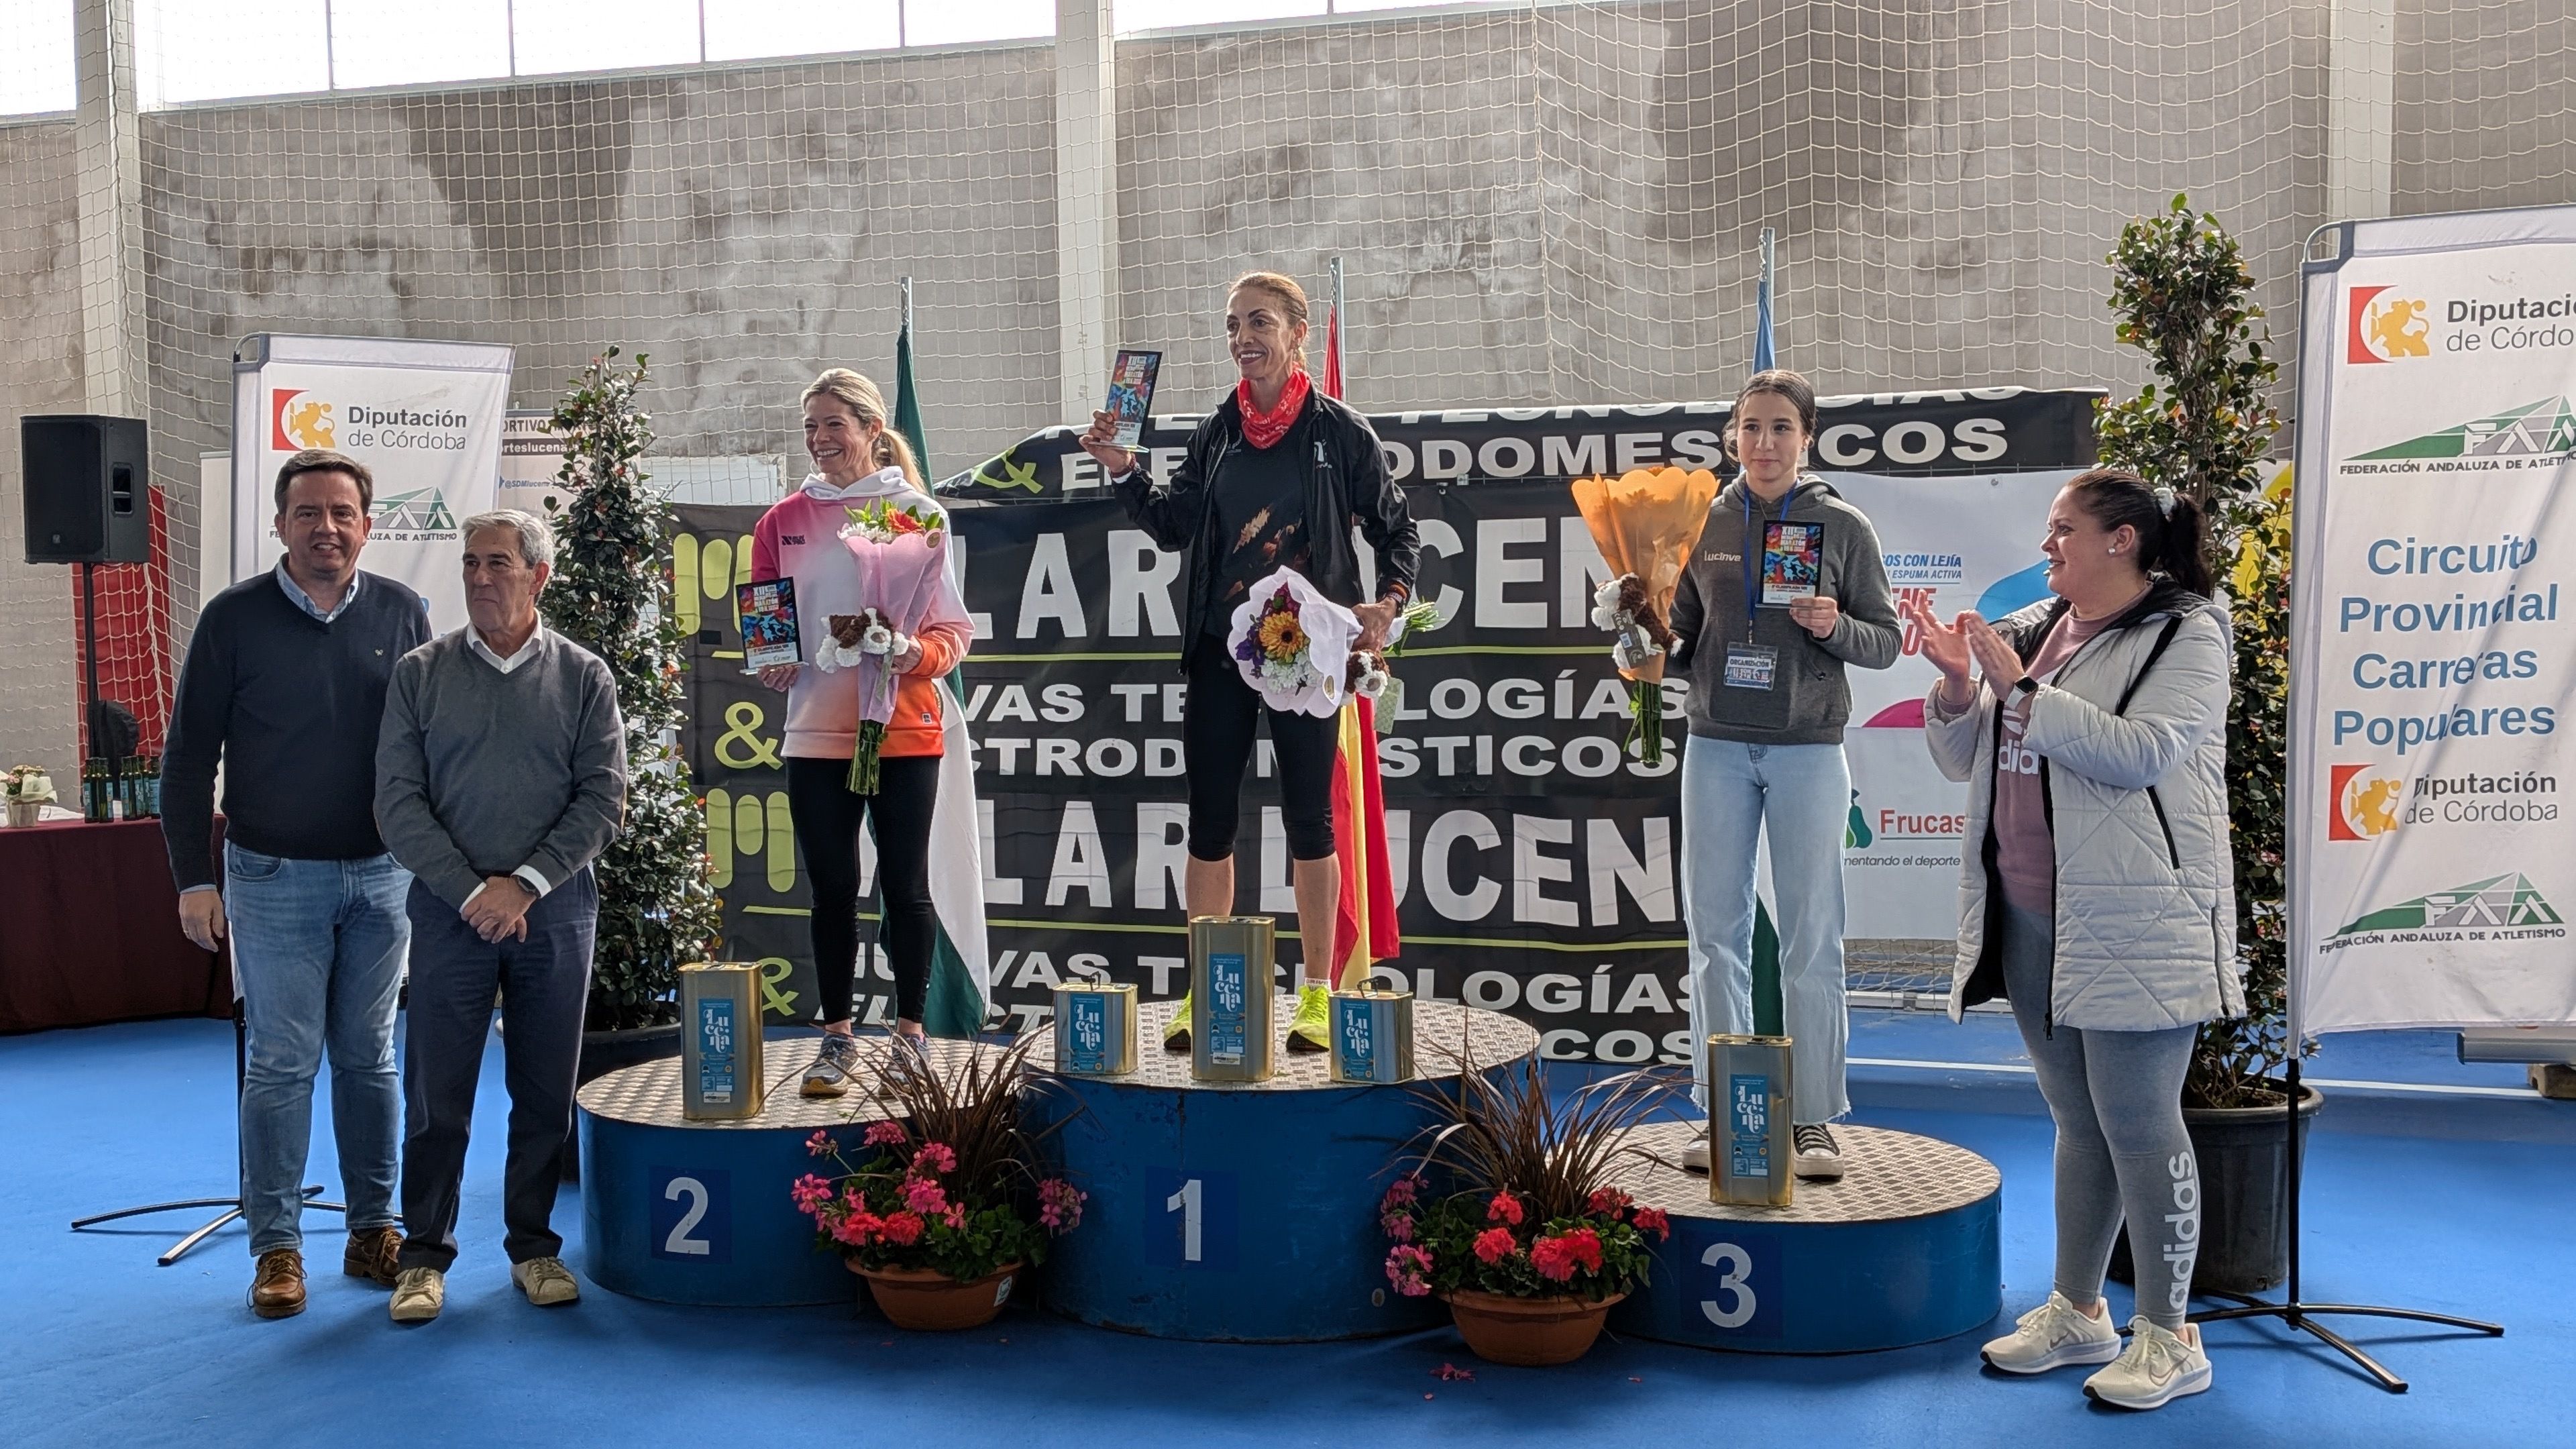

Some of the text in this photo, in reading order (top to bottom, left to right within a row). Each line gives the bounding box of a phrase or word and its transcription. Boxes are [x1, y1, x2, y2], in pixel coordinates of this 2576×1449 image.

[2447, 293, 2576, 327] Diputaci
[2446, 329, 2481, 352] de
[348, 406, 468, 429] Diputación
[348, 429, 466, 450] de Córdoba
[2339, 460, 2420, 475] FEDERACIÓN
[2426, 460, 2500, 472] ANDALUZA
[2506, 460, 2522, 470] DE
[395, 533, 409, 541] DE
[412, 532, 458, 542] ATLETISMO
[1903, 554, 1929, 567] CON
[1930, 553, 1962, 568] LEJÍA
[2367, 534, 2538, 576] Circuito
[1892, 570, 1929, 579] ESPUMA
[1930, 570, 1962, 579] ACTIVA
[2340, 583, 2559, 633] Provincial
[2405, 799, 2559, 824] de Córdoba
[1902, 855, 1913, 866] el
[1915, 855, 1961, 869] deporte
[2390, 932, 2464, 943] ANDALUZA
[2469, 931, 2486, 941] DE
[2491, 928, 2566, 940] ATLETISMO
[665, 1177, 710, 1256] 2
[1167, 1179, 1202, 1261] 1
[2163, 1150, 2198, 1309] adidas
[1699, 1242, 1758, 1329] 3
